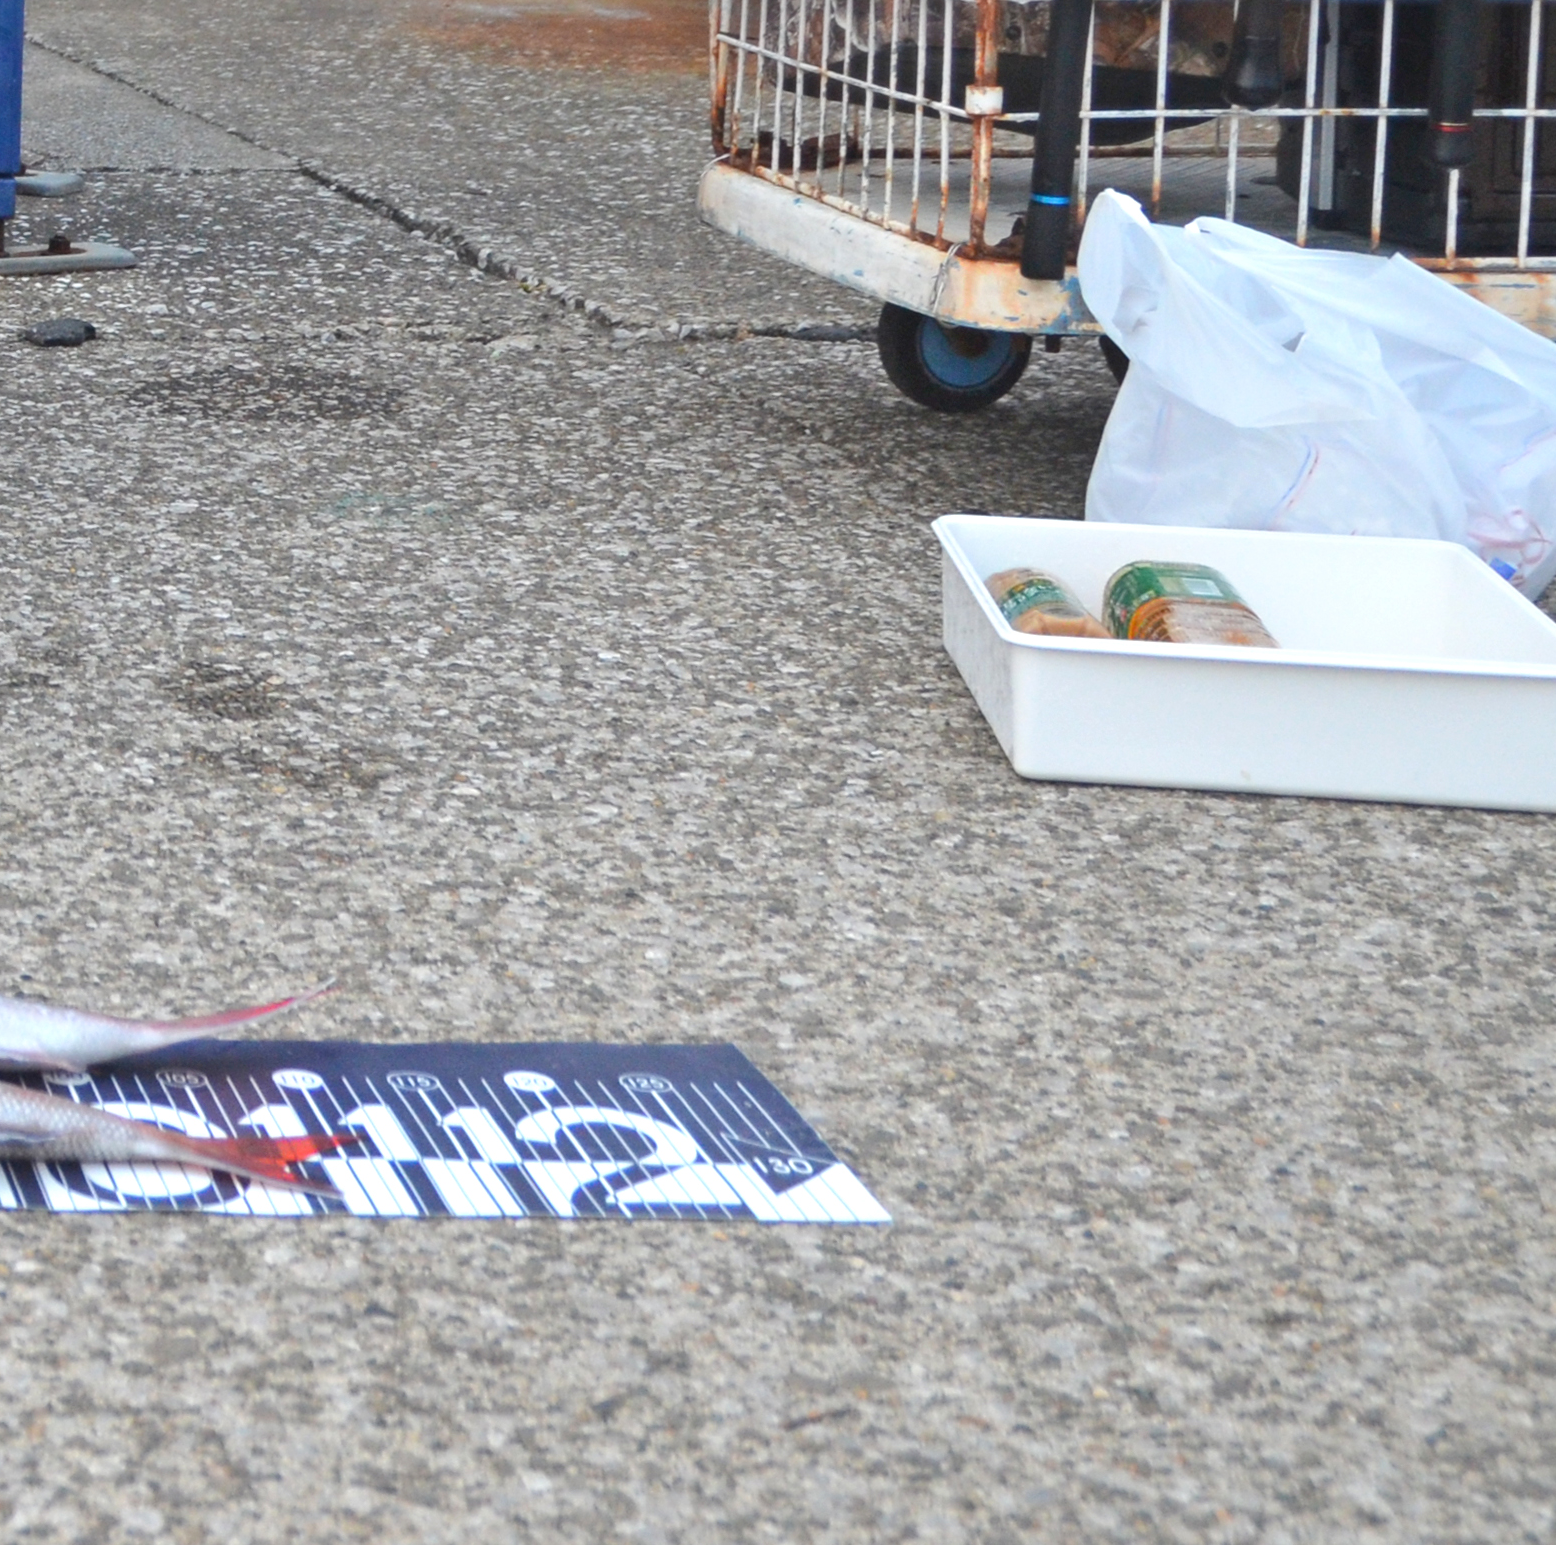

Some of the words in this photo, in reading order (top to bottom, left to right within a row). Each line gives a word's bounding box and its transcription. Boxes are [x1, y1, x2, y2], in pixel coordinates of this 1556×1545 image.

[165, 1072, 199, 1084] 105
[280, 1074, 316, 1085] 110
[395, 1075, 431, 1087] 115
[512, 1075, 548, 1087] 120
[627, 1077, 664, 1089] 125
[753, 1156, 813, 1174] 130
